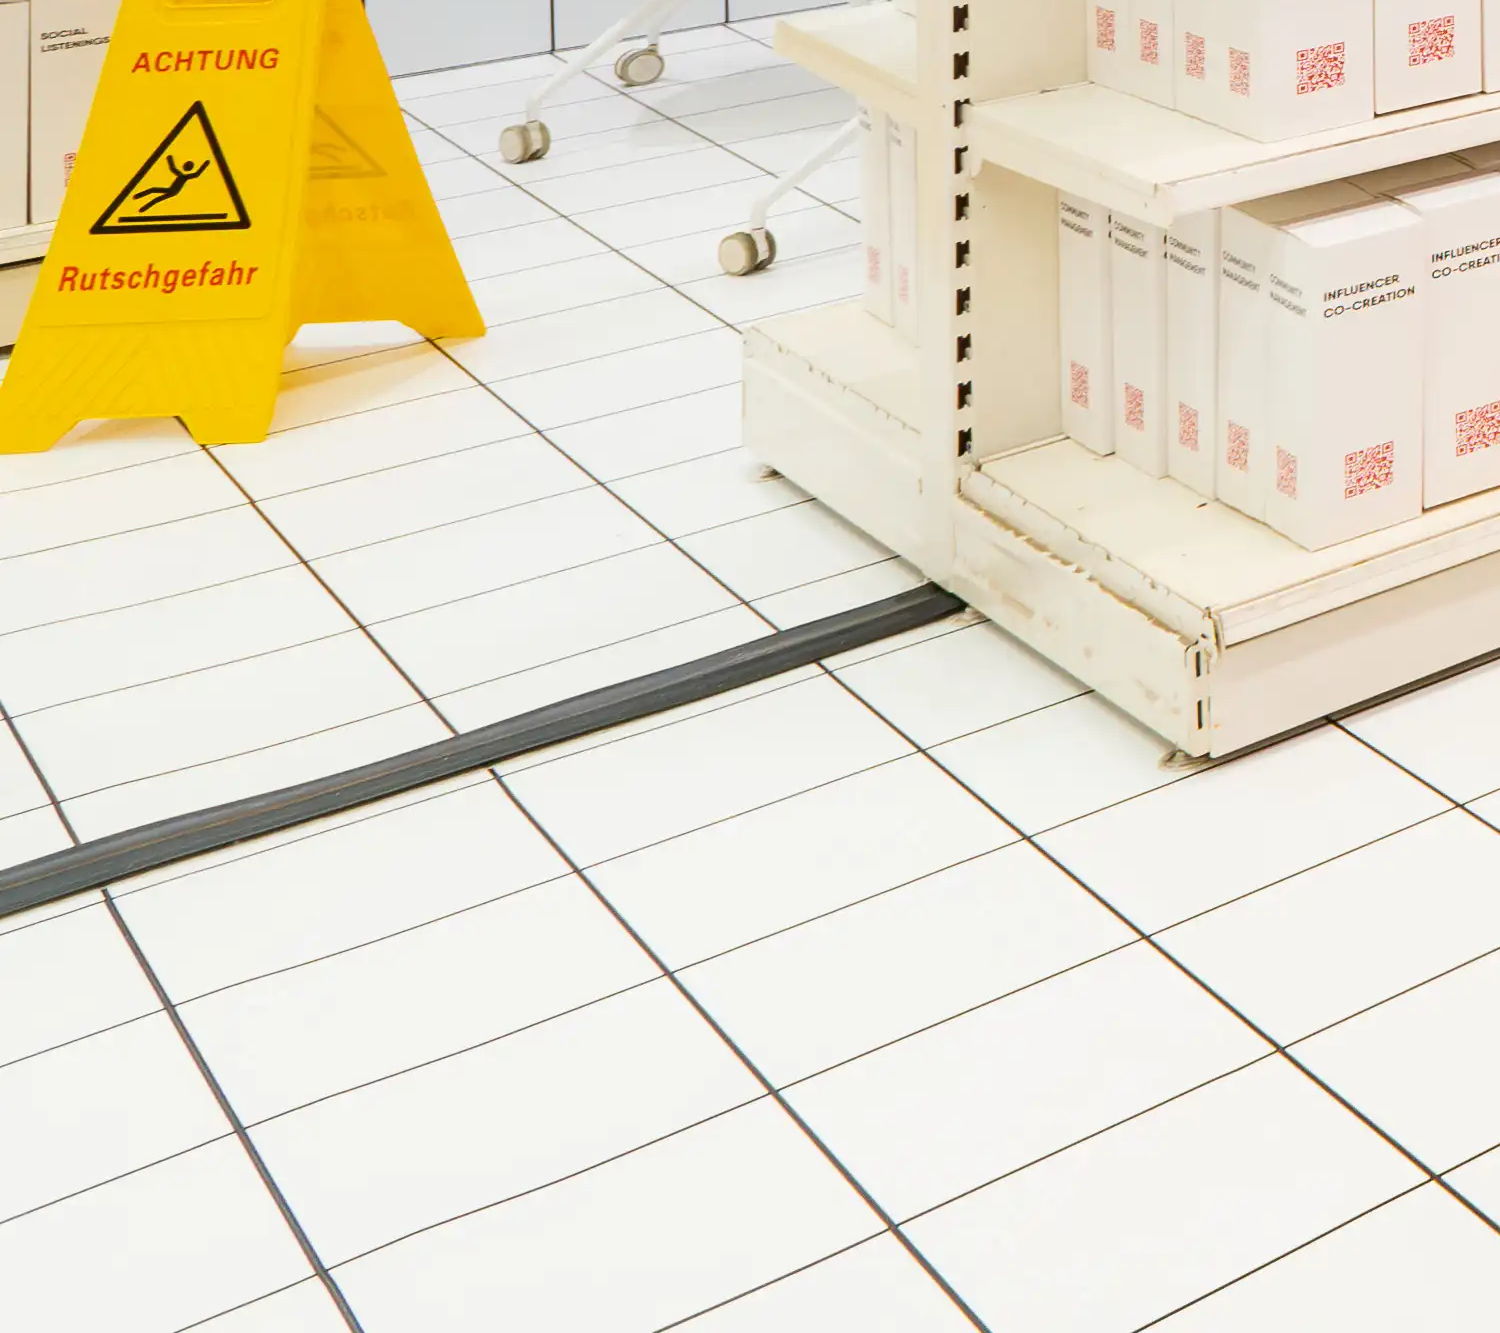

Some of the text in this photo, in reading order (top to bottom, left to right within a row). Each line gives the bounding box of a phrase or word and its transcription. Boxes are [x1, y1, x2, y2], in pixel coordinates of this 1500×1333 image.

[41, 27, 88, 40] SOCIAL
[41, 36, 110, 53] LISTENINGS
[131, 47, 280, 73] ACHTUNG
[58, 259, 258, 295] Rutschgefahr
[1323, 274, 1400, 303] INFLUENCER
[1323, 285, 1416, 319] CO-CREATION
